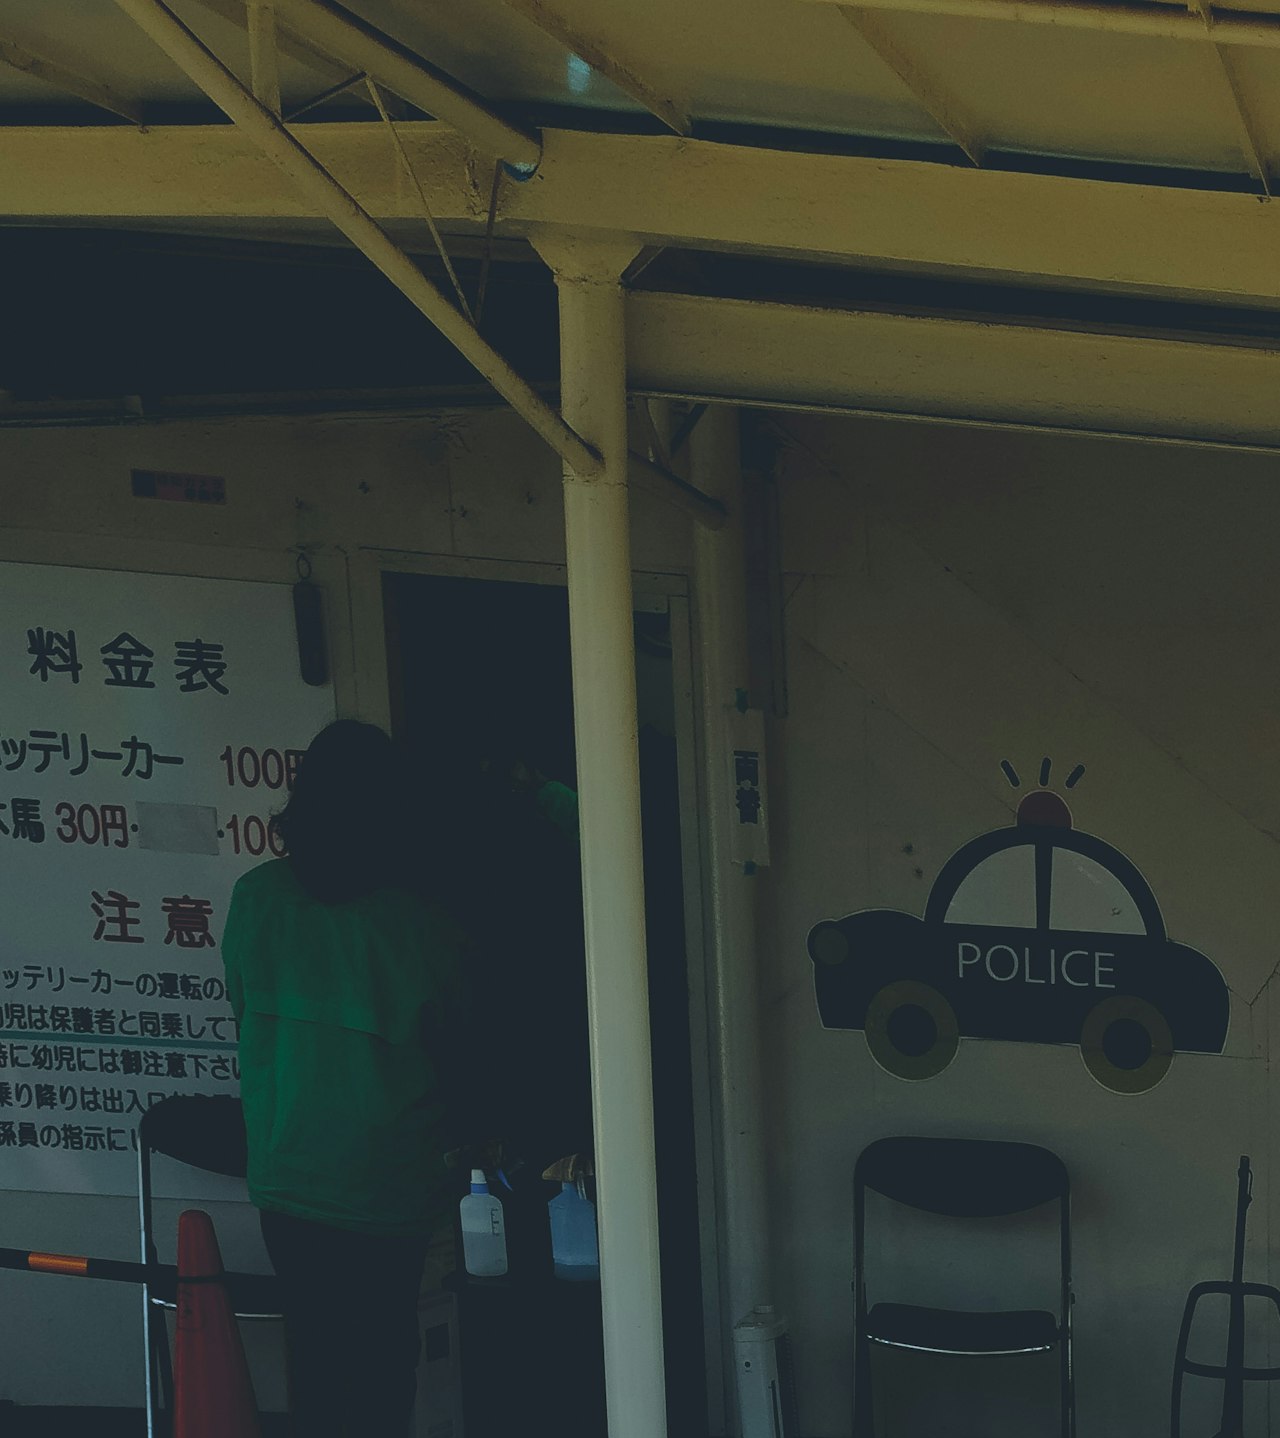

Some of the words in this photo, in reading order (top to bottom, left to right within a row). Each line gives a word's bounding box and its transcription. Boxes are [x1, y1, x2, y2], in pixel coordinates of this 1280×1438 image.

[27, 627, 229, 695] 料金表
[0, 730, 184, 780] ッテリーカー
[90, 890, 216, 948] 注意
[3, 964, 230, 1001] ッテリーカーの運転の
[958, 942, 1116, 988] POLICE
[0, 1002, 241, 1042] 児は保護者と同乗して下
